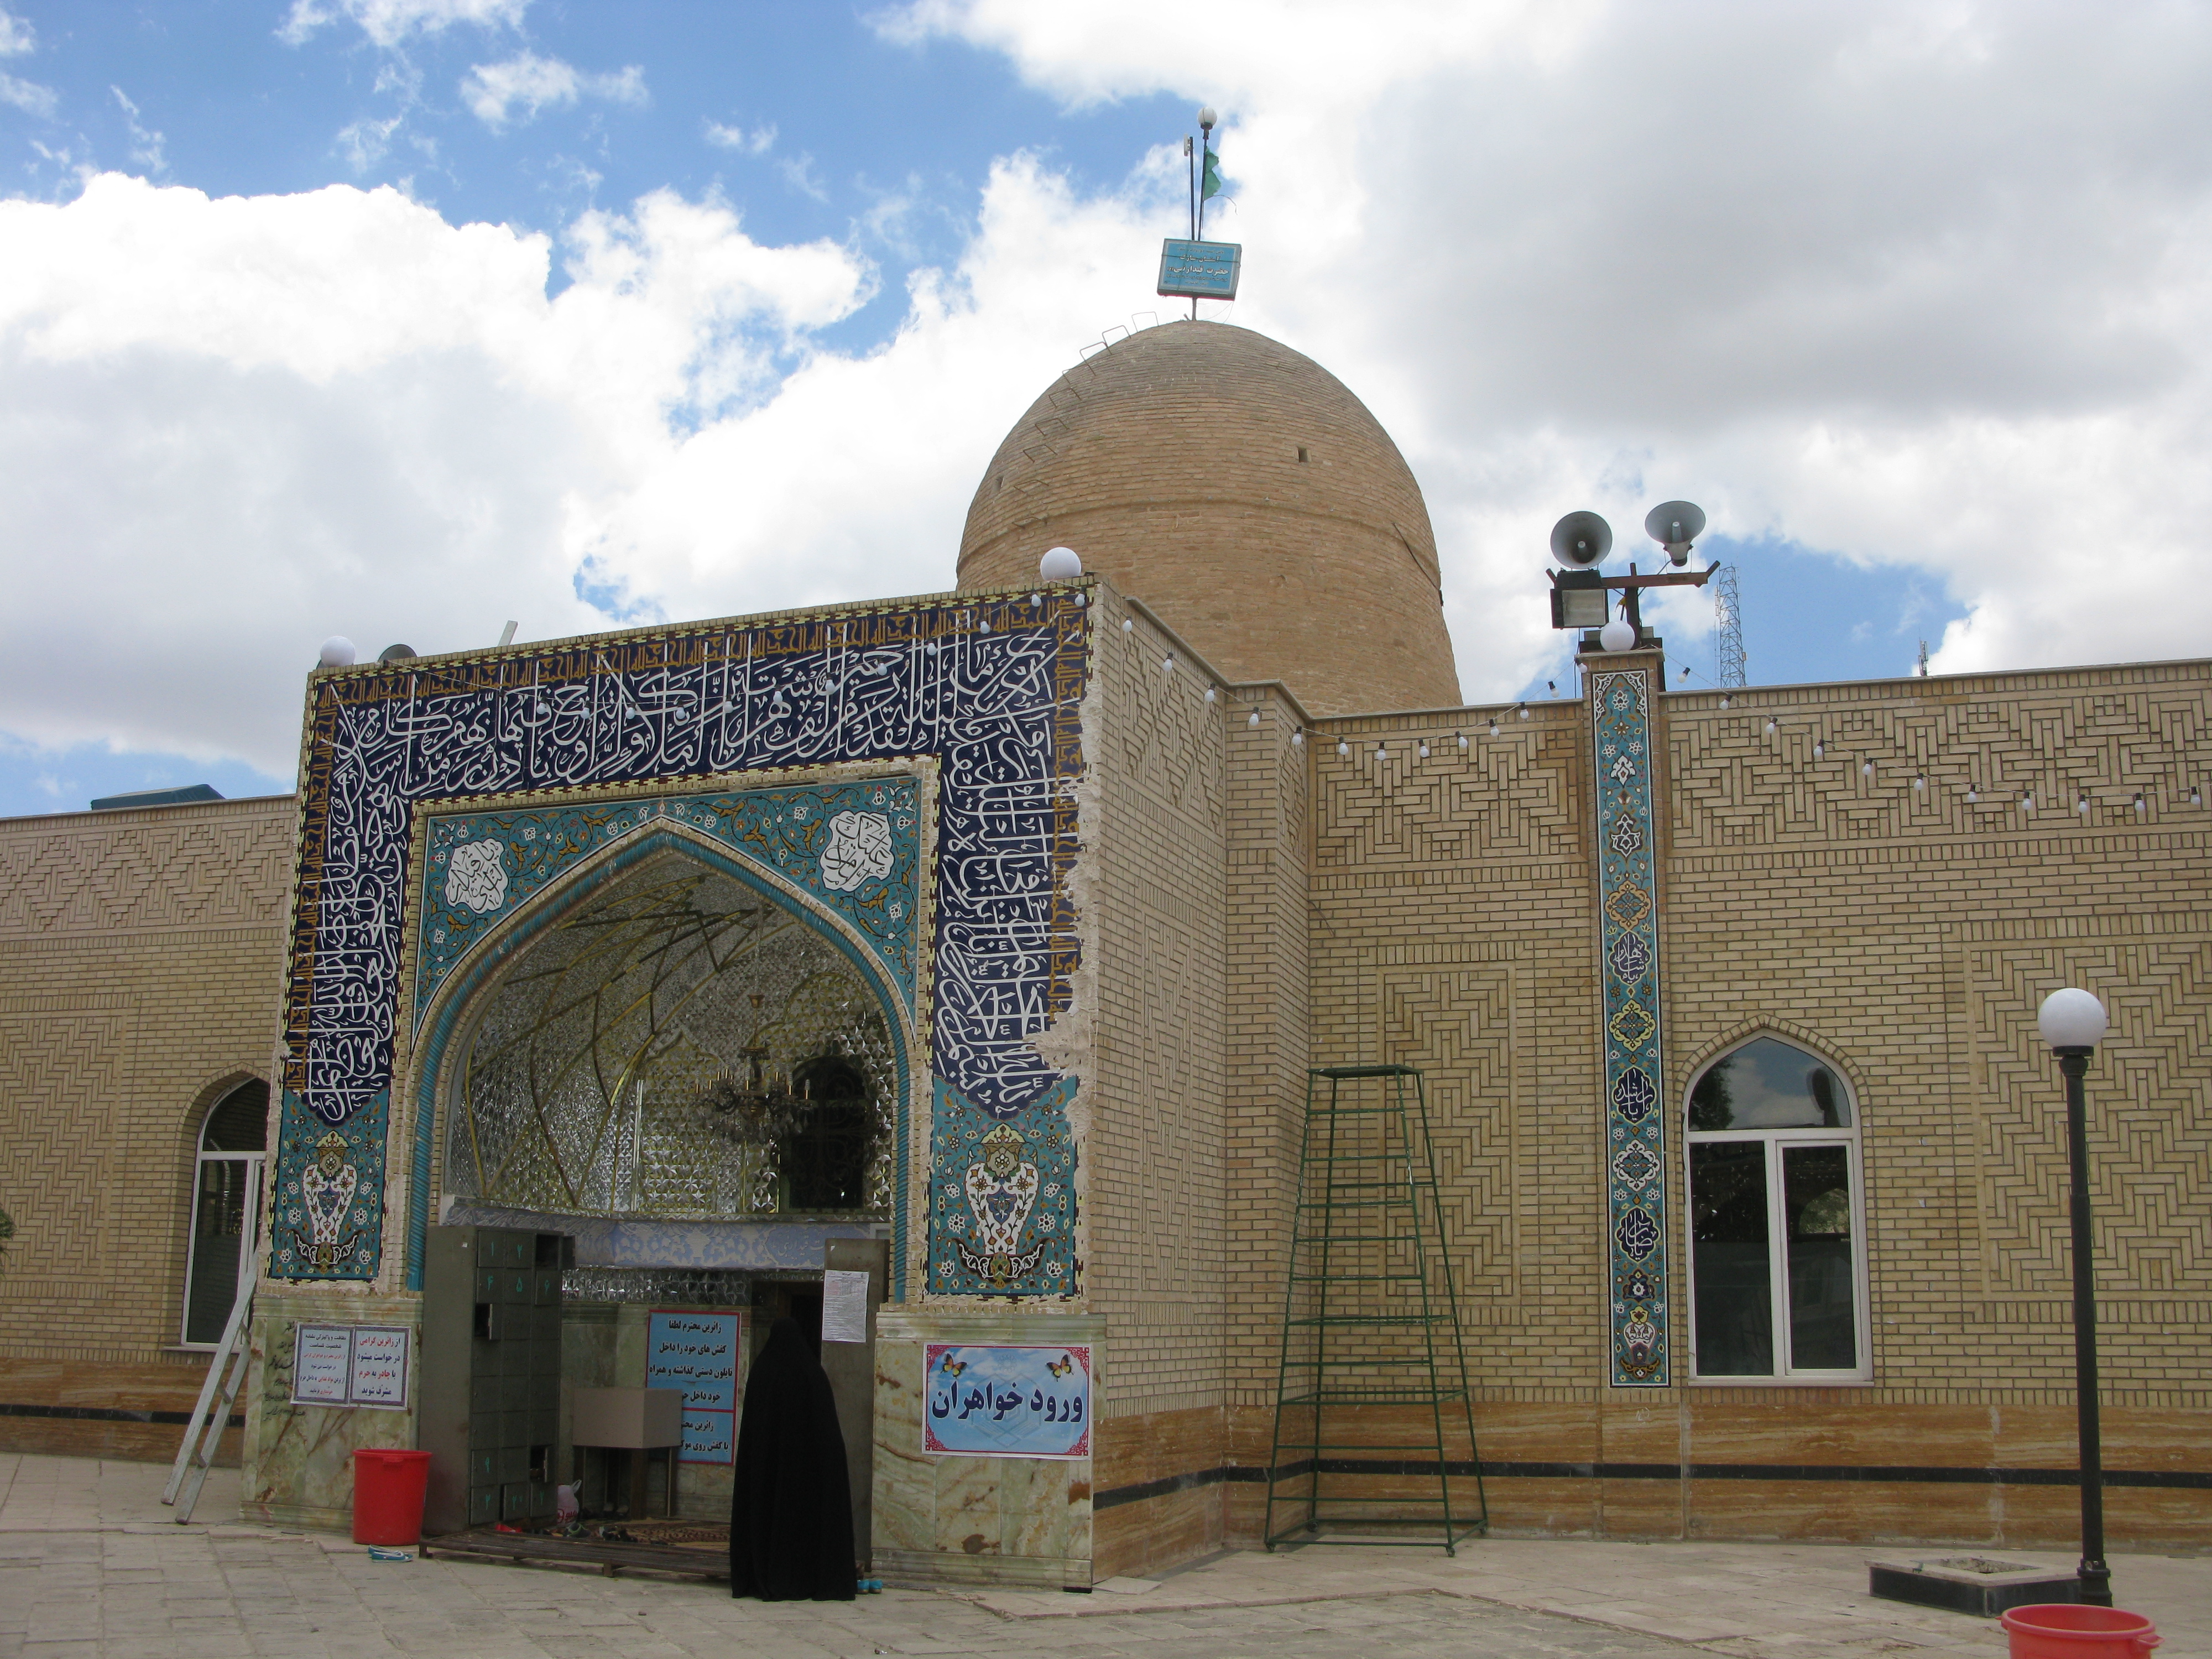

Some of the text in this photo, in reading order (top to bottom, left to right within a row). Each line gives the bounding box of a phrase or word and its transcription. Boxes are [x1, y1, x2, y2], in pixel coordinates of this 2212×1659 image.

[1185, 265, 1204, 275] قیدار
[1206, 268, 1229, 277] حضرت
[516, 1276, 523, 1292] ۵
[682, 1322, 701, 1332] محترم
[702, 1321, 722, 1333] زائرین
[359, 1335, 401, 1348] از زائرین گرامی
[659, 1342, 727, 1356] کفش های خود را داخل
[373, 1353, 392, 1364] خواست
[393, 1355, 401, 1364] در
[358, 1370, 371, 1380] حرم
[371, 1370, 377, 1379] به
[392, 1369, 397, 1380] با
[649, 1364, 733, 1379] نایلون دستی گذاشته و همراه
[361, 1387, 375, 1397] شوید
[690, 1390, 707, 1402] داخل
[707, 1391, 721, 1404] خود
[932, 1380, 1083, 1423] ورود خواهران
[695, 1420, 714, 1432] زائرین
[693, 1442, 707, 1452] روی
[707, 1441, 723, 1452] کفش
[723, 1441, 729, 1453] با
